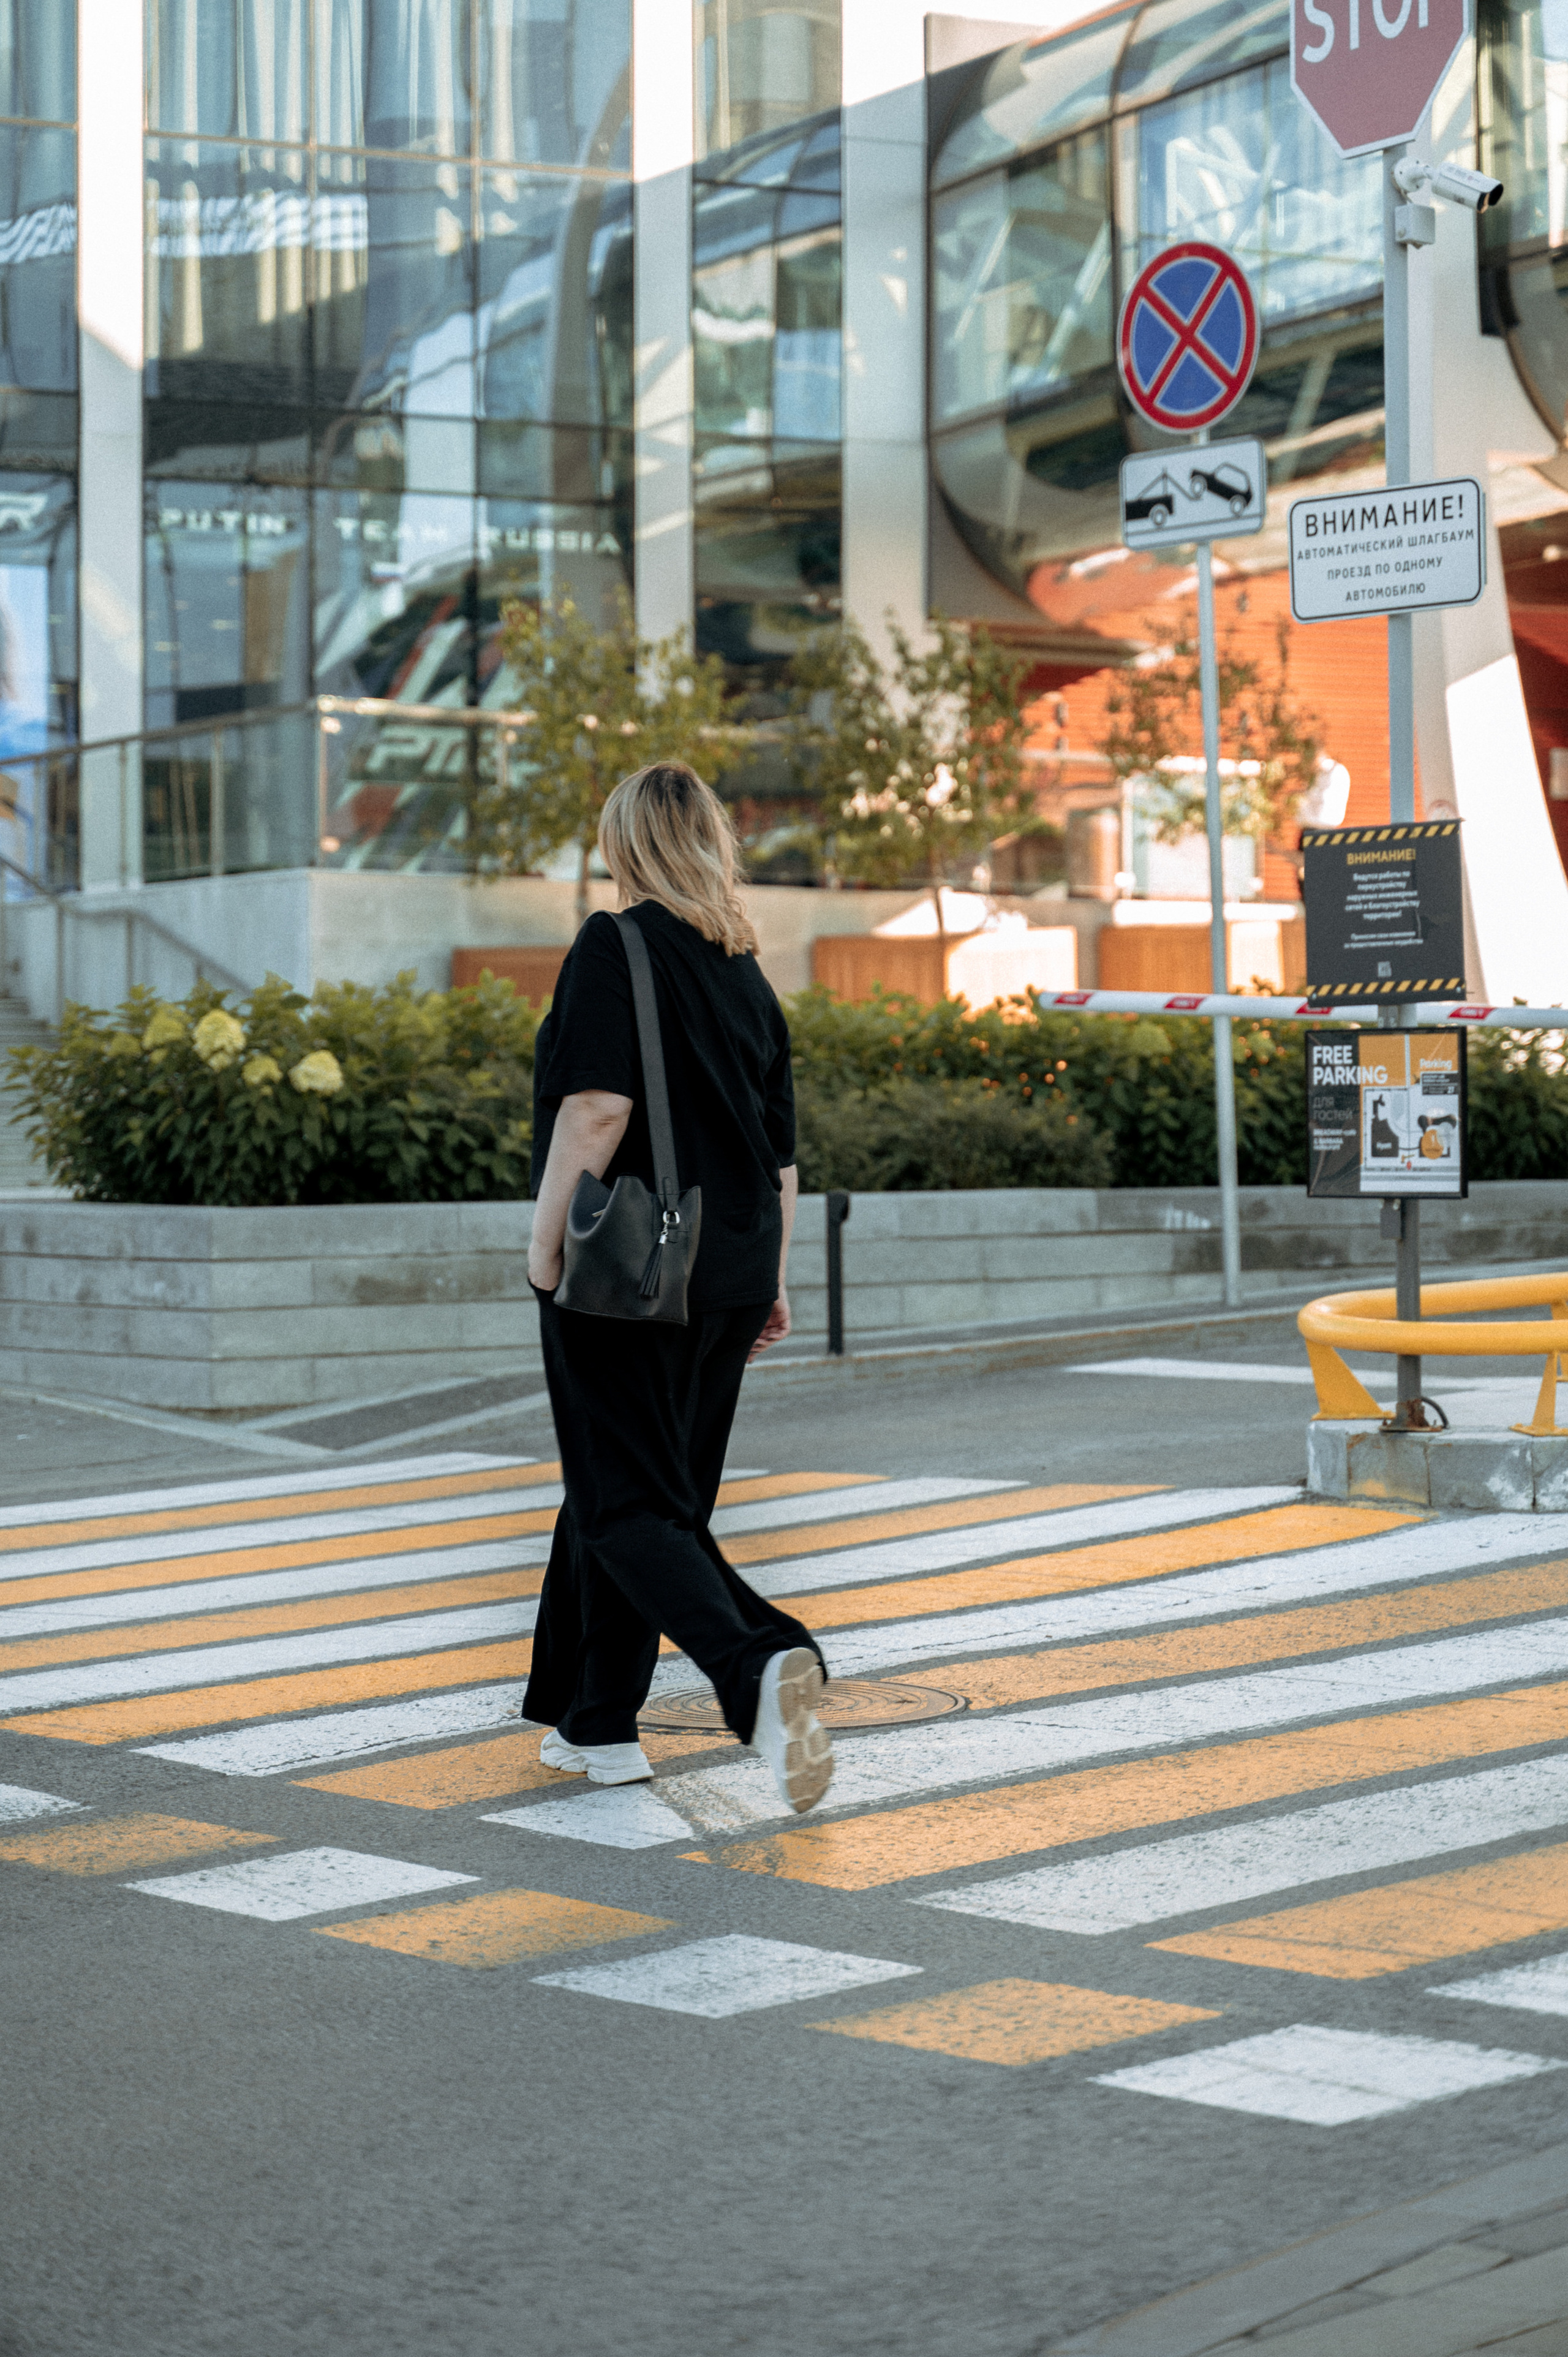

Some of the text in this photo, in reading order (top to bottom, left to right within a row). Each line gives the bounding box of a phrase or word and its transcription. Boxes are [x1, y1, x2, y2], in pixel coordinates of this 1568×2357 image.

[1302, 0, 1430, 63] ST
[1305, 494, 1464, 537] ВНИМАНИЕ!
[1297, 529, 1475, 561] АВТОМАТИЧЕСКИЙ ШЛАГБАУМ
[1327, 556, 1444, 580] ПРОЕЗД ПО ОДНОМУ
[1345, 582, 1427, 602] АВТОМОБИЛЮ
[1346, 848, 1416, 866] ВНИМАНИЕ!
[1312, 1045, 1353, 1065] FREE
[1419, 1058, 1453, 1071] Parking
[1312, 1065, 1389, 1086] PARKING
